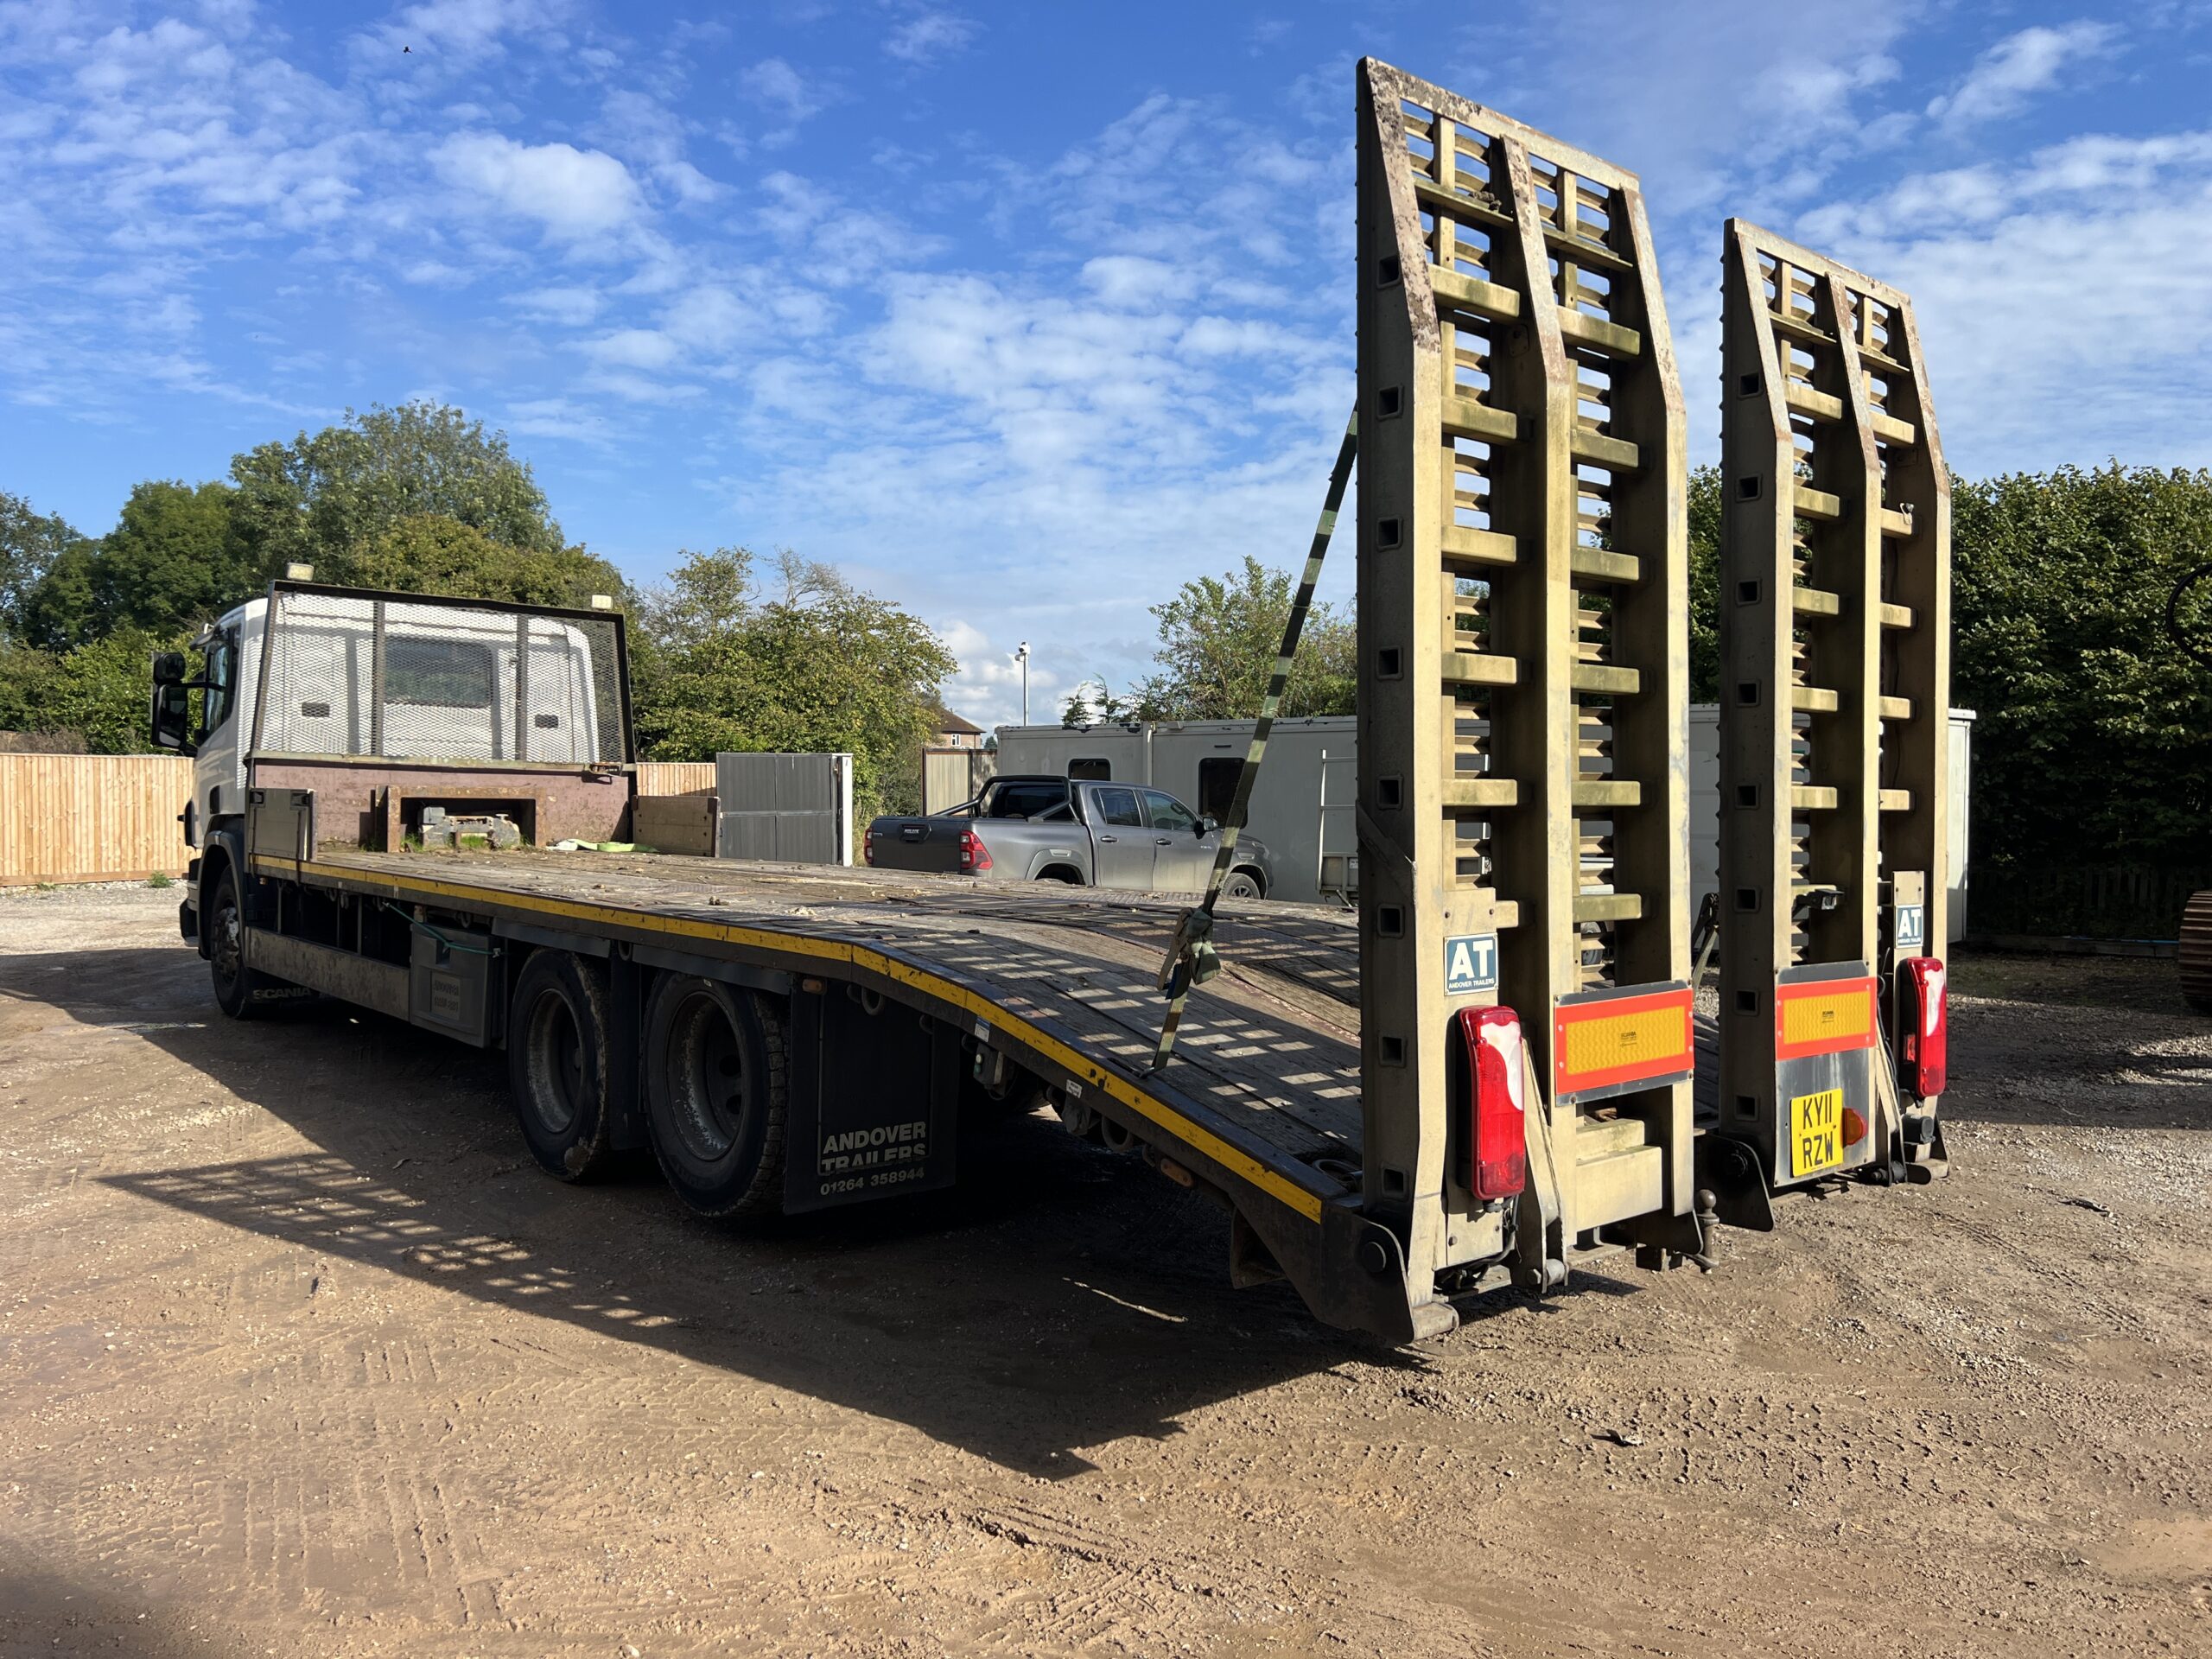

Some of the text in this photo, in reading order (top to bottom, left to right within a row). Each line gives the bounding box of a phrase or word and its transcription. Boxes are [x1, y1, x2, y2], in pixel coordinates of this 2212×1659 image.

[1897, 908, 1922, 938] AT
[1448, 939, 1494, 981] AT
[252, 987, 312, 1001] SCANIA
[1472, 977, 1495, 987] TRAILERS
[1802, 1092, 1833, 1130] KY11
[822, 1121, 926, 1154] ANDOVER
[1802, 1130, 1834, 1169] RZW
[821, 1142, 926, 1172] TRAILERS
[819, 1166, 925, 1196] 01264 358944
